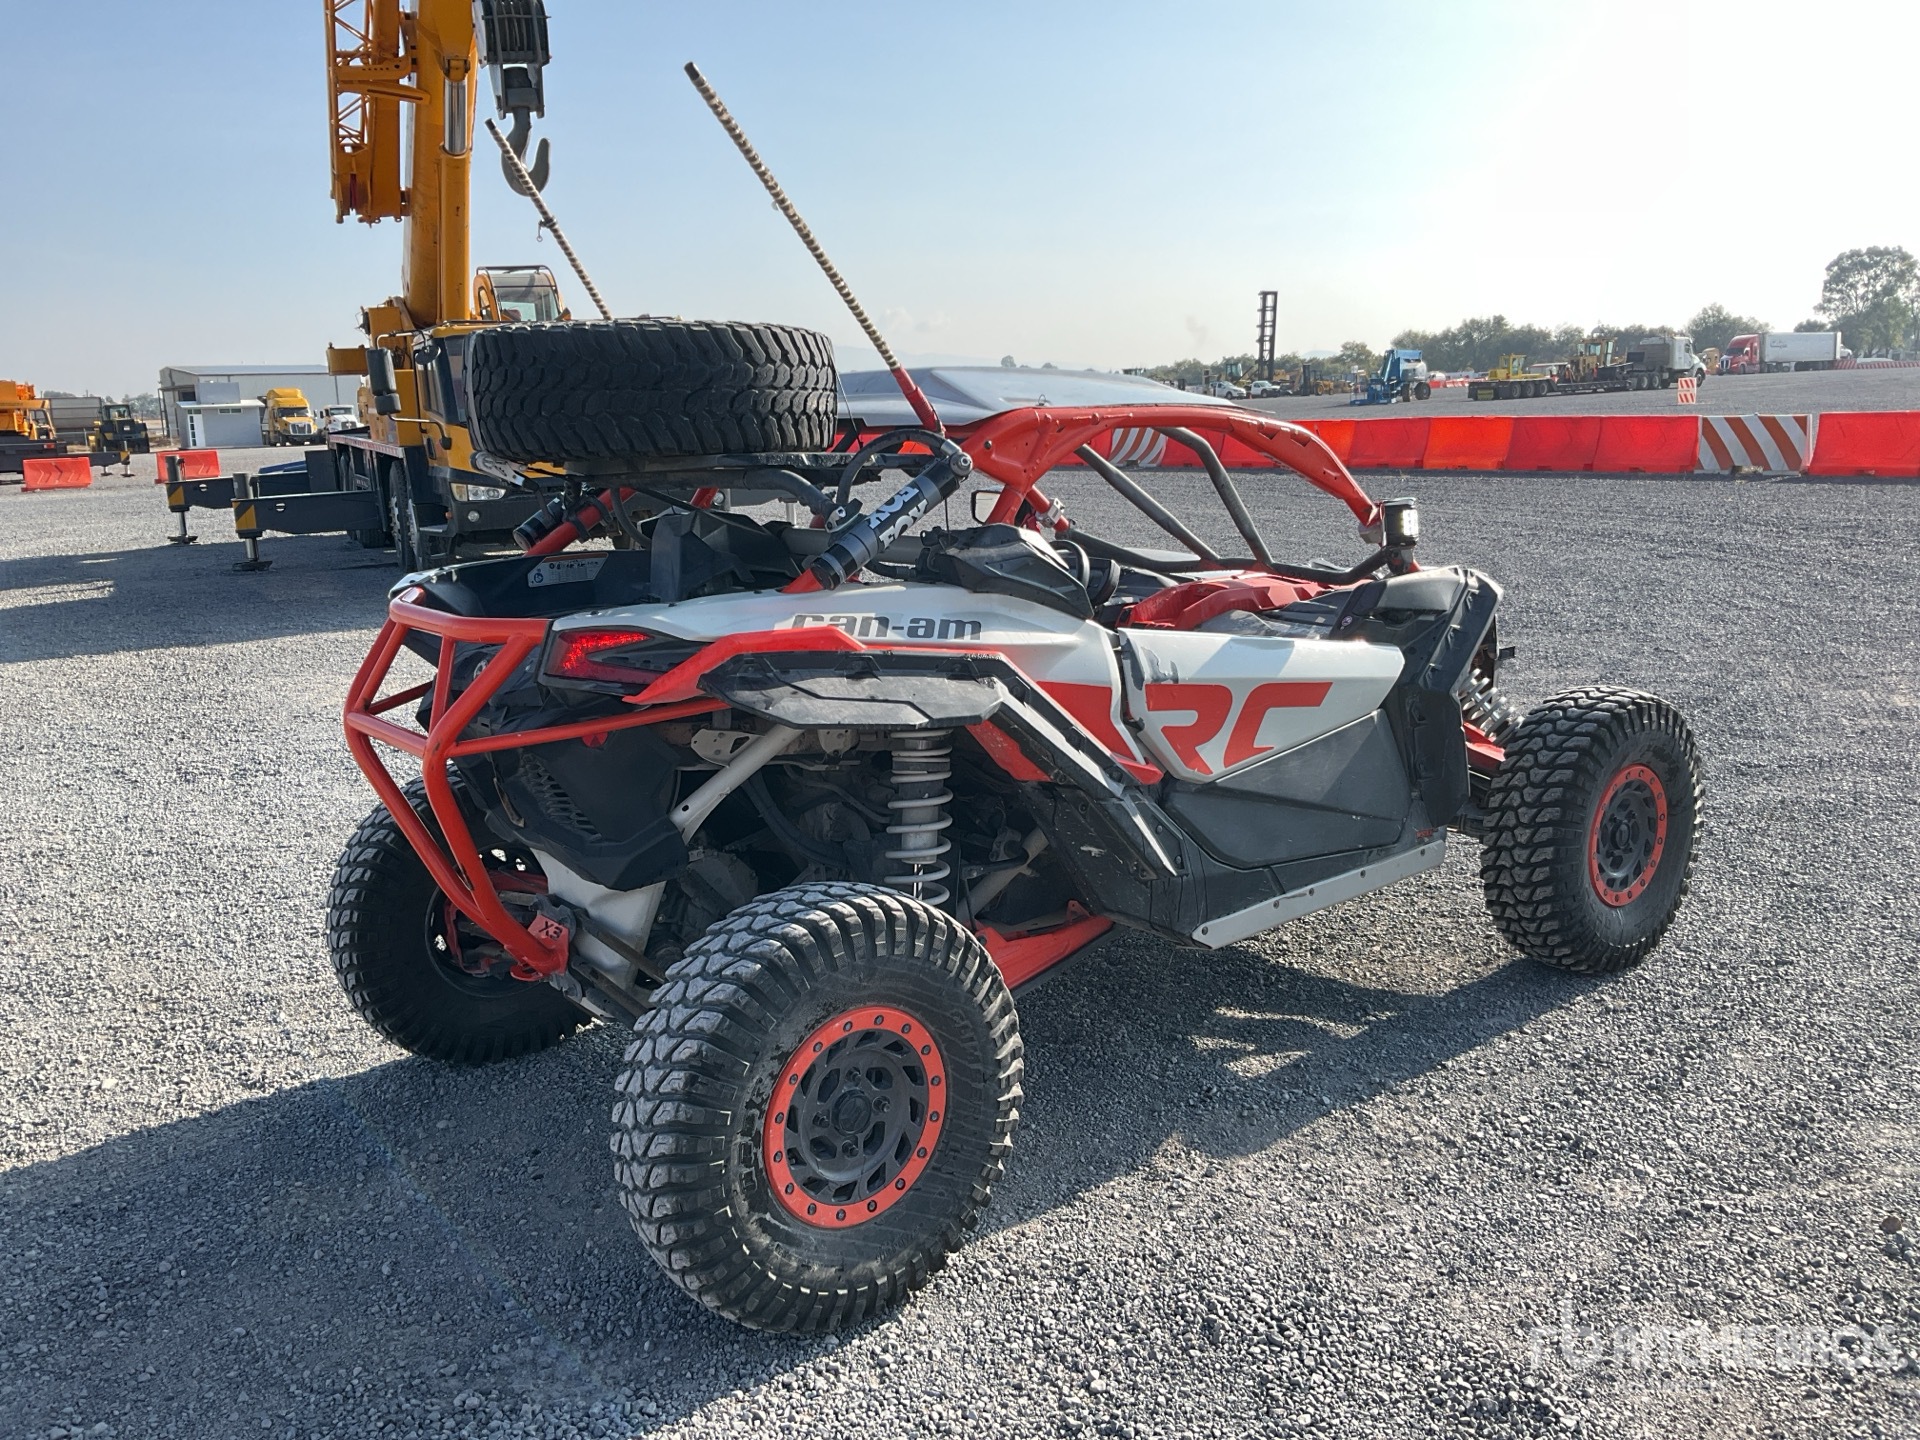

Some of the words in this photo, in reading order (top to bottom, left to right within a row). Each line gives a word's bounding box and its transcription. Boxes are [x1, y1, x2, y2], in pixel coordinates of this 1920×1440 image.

[868, 486, 920, 530] FOX
[878, 498, 928, 549] FOX
[791, 613, 982, 641] can-am
[538, 920, 563, 941] X3
